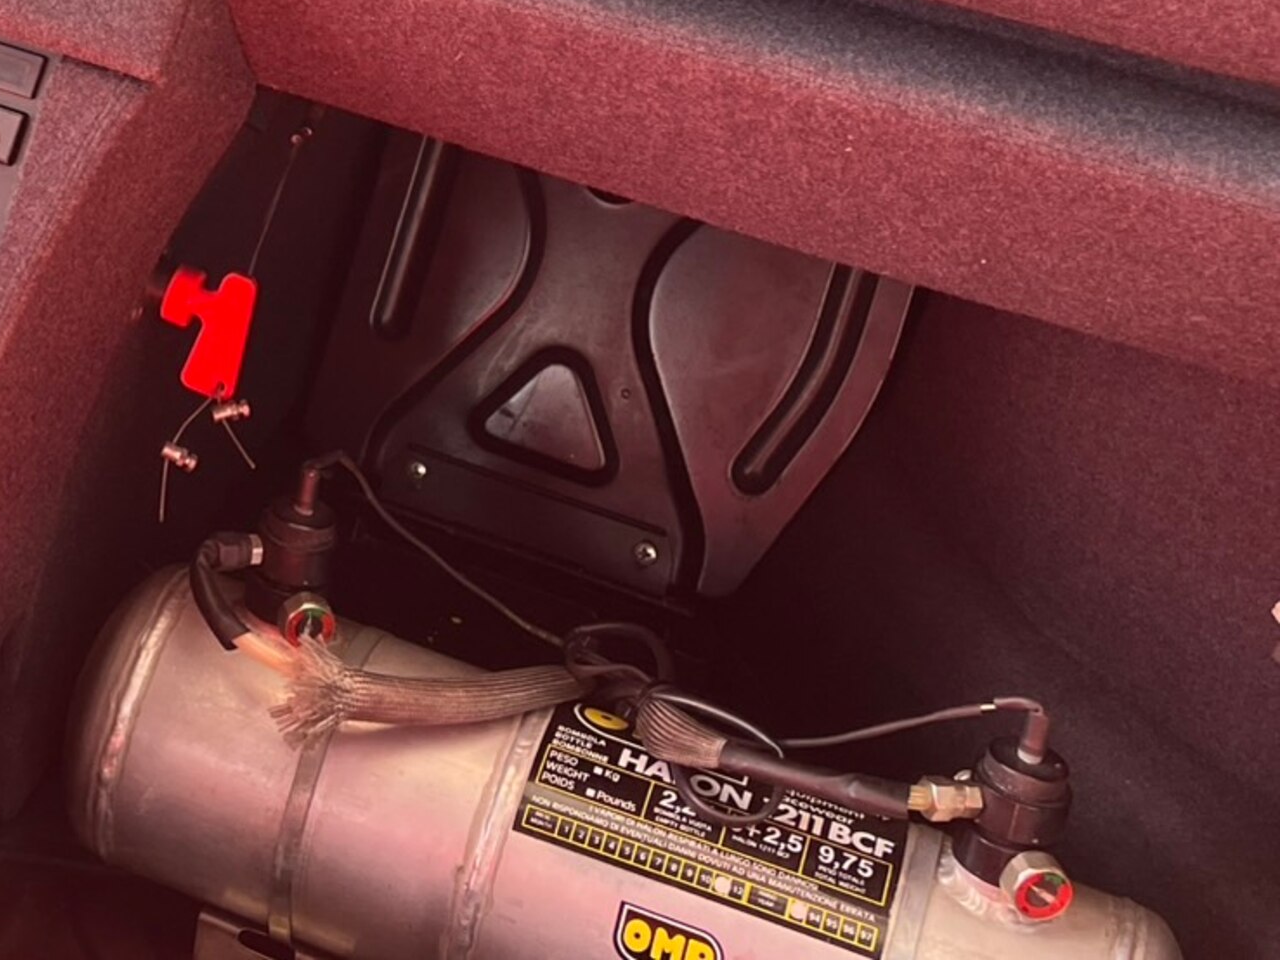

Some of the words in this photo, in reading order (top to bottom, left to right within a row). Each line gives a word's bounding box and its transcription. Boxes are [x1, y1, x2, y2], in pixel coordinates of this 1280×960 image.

[549, 749, 579, 767] PESO
[541, 771, 575, 790] POIDS
[546, 760, 590, 782] WEIGHT
[604, 769, 621, 783] Kg
[596, 789, 636, 812] Pounds
[617, 747, 753, 810] HAON
[768, 803, 825, 837] 211
[827, 821, 895, 858] BCF
[818, 845, 874, 878] 9,75
[623, 919, 715, 960] OMP
